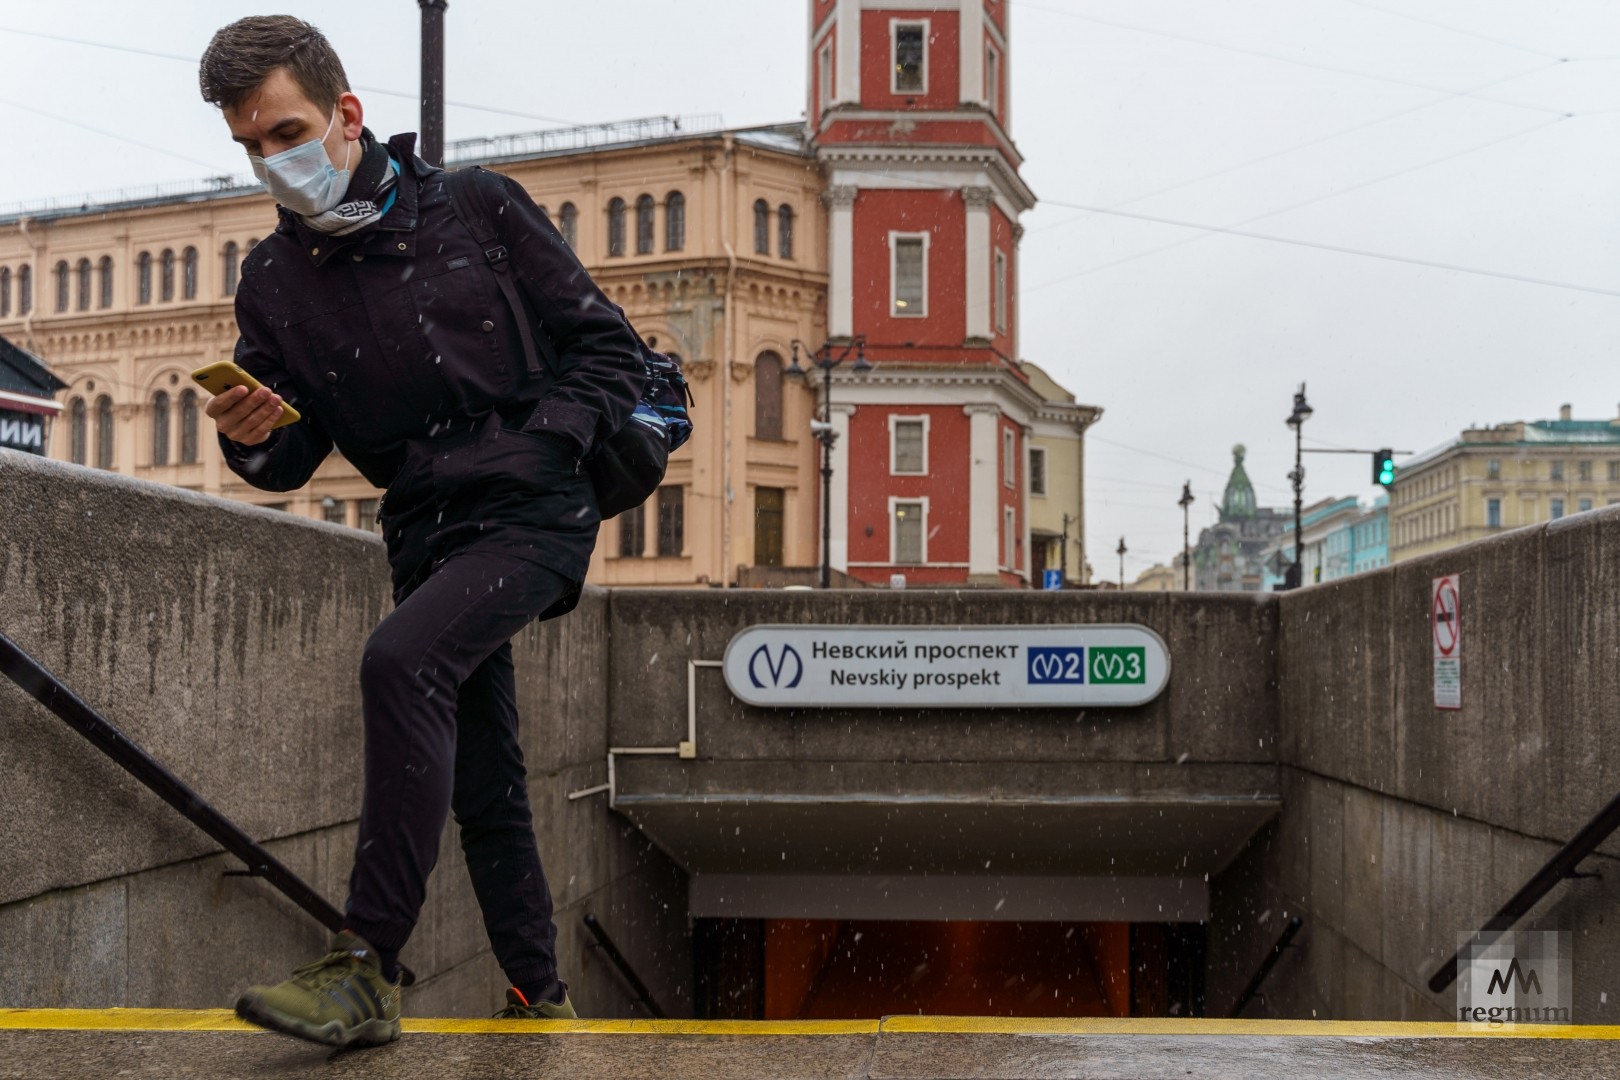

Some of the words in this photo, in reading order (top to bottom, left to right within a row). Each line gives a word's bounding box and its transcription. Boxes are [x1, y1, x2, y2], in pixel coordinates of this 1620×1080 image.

[812, 641, 908, 659] Невский
[914, 645, 1019, 663] проспект
[830, 668, 908, 690] Nevskiy
[913, 668, 1001, 690] prospekt
